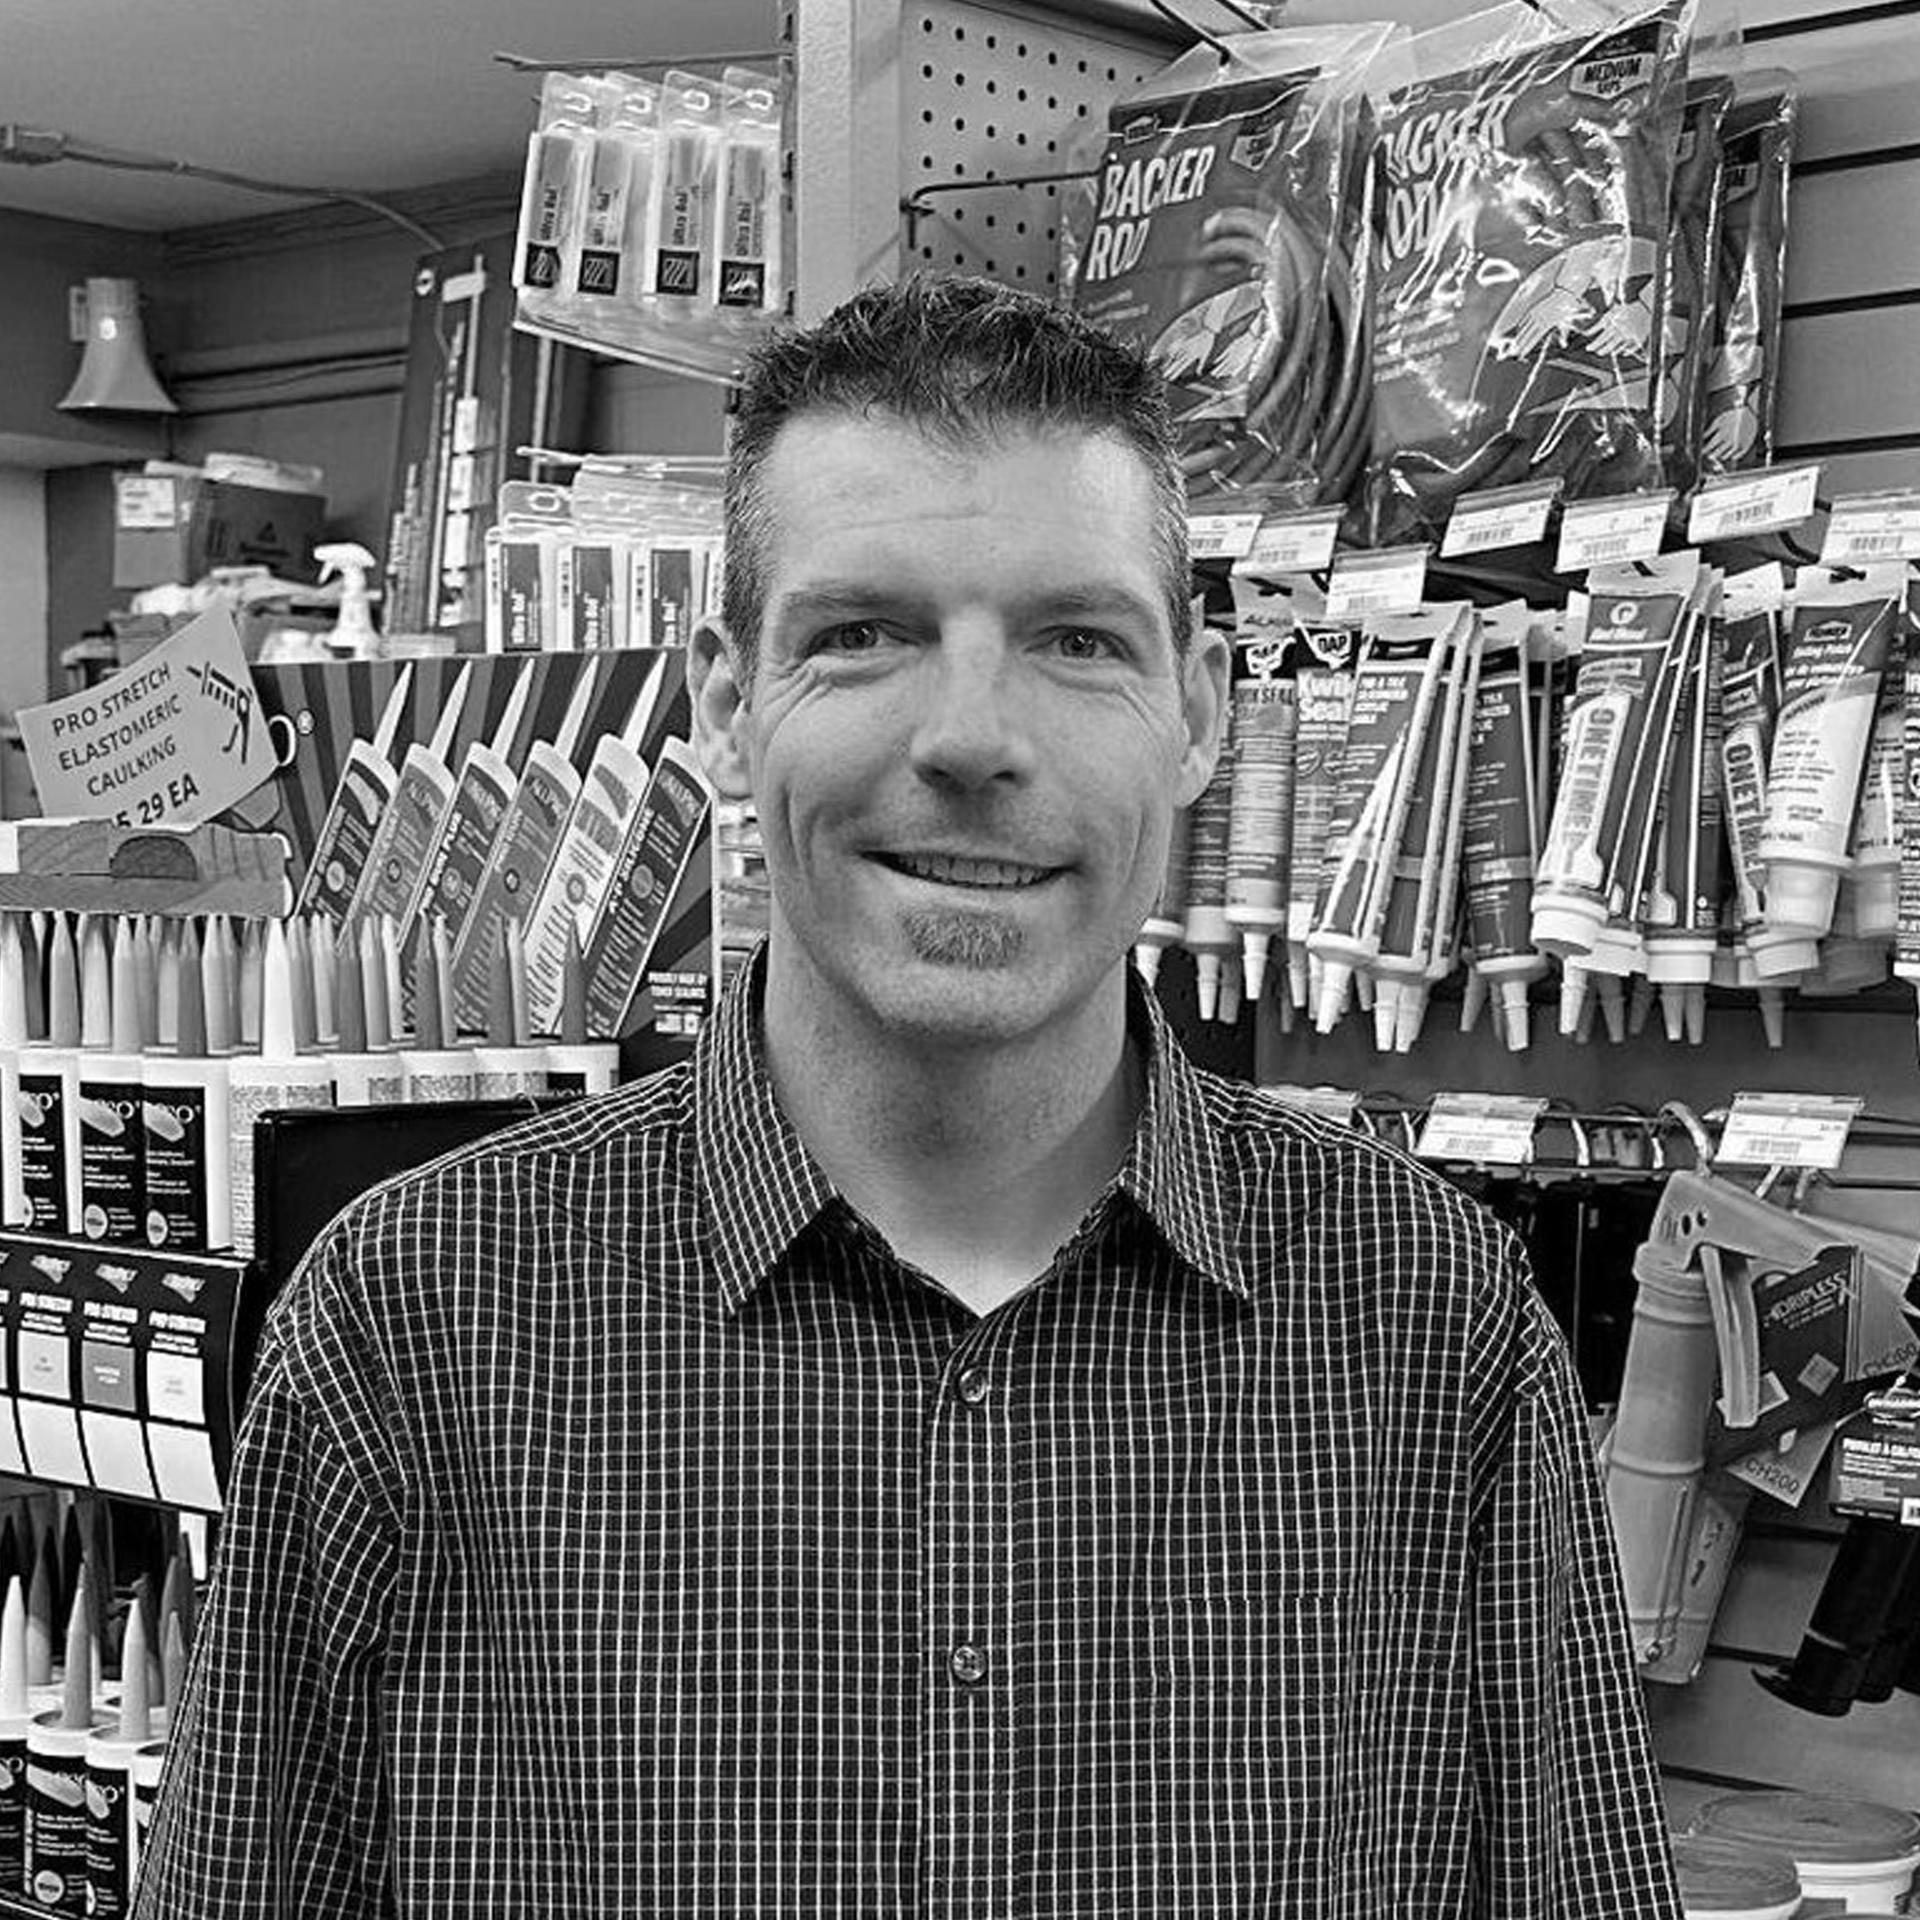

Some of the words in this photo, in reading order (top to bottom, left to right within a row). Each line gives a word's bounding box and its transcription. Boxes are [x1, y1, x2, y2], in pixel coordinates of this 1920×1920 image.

[1584, 57, 1642, 83] MEDIUM
[1098, 146, 1215, 219] BACKER
[1085, 218, 1151, 282] ROD
[1318, 635, 1347, 655] DAP
[51, 706, 98, 738] PRO
[103, 663, 171, 720] STRETCH
[58, 693, 182, 771] ELASTOMERIC
[86, 734, 177, 797] CAULKING
[167, 772, 200, 809] EA
